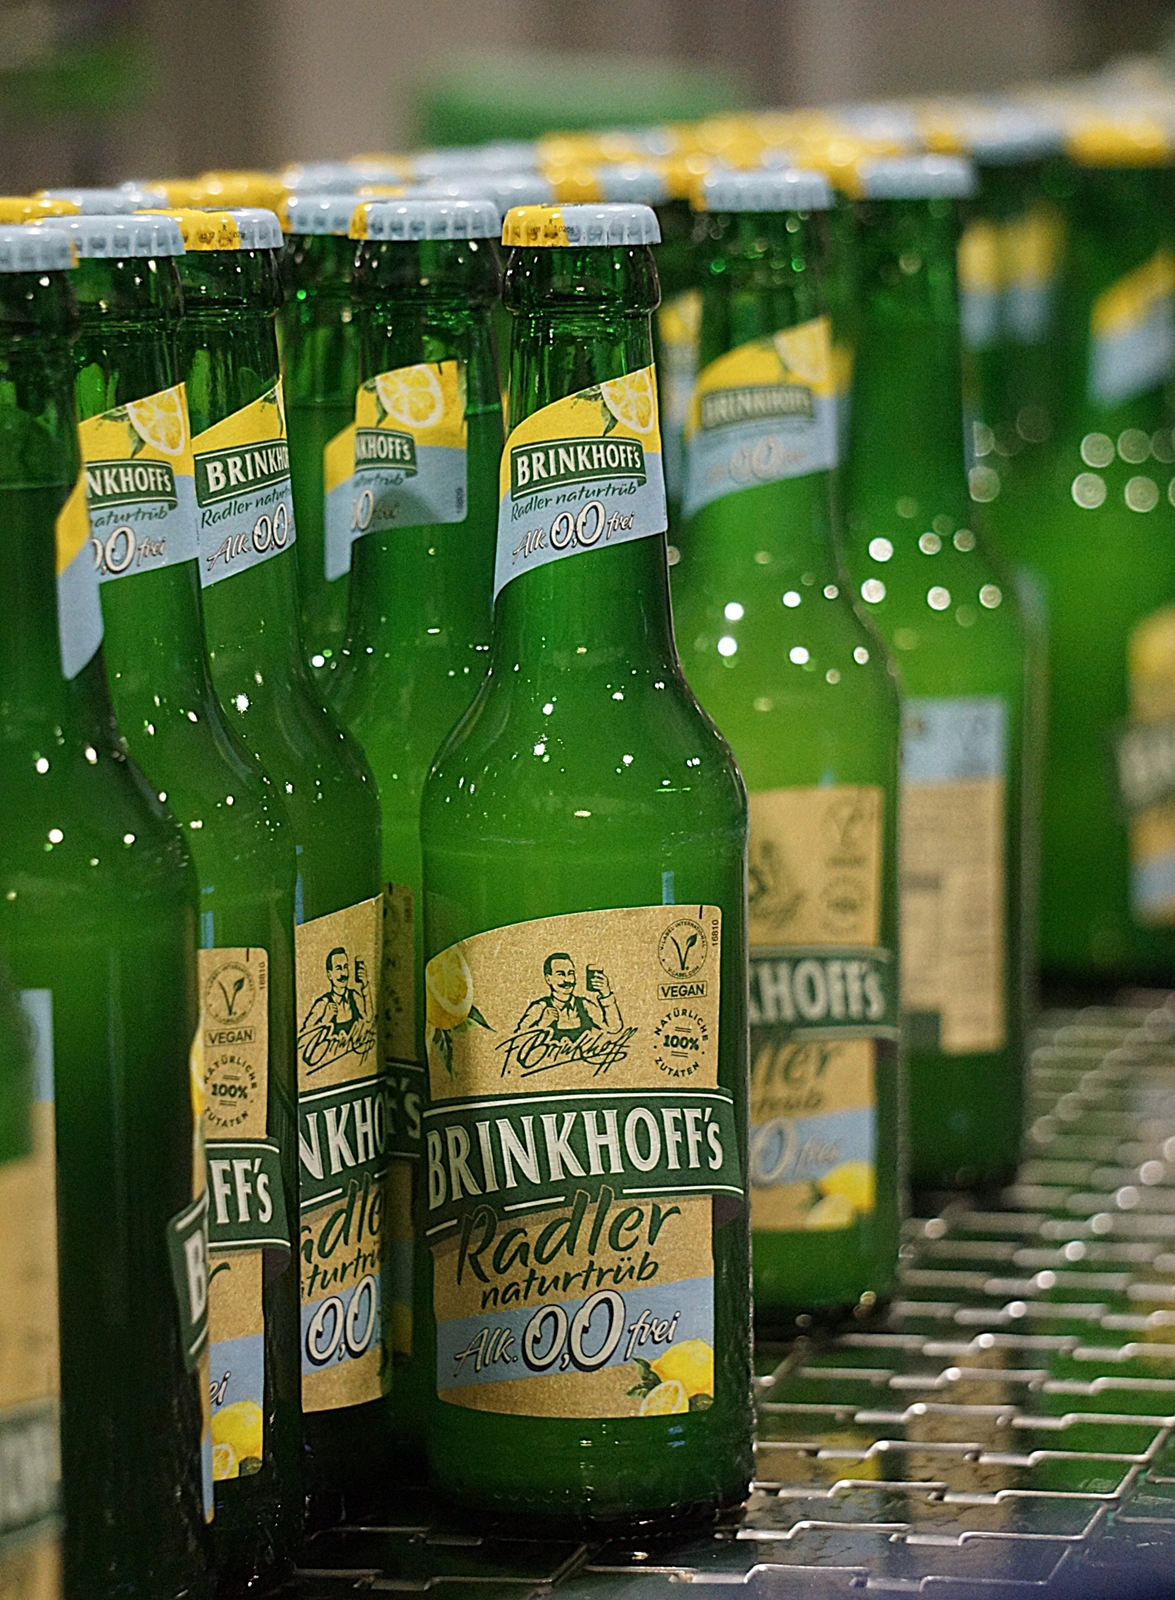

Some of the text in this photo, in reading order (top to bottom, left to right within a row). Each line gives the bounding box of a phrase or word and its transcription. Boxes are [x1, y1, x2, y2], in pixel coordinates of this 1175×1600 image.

[516, 443, 642, 488] BRINKHOFF's
[90, 506, 168, 528] aturtrüb
[201, 499, 254, 530] Radler
[511, 482, 638, 522] Radler naturtrüb
[511, 529, 549, 565] Alk.
[606, 511, 636, 540] frei
[711, 919, 719, 947] 16810
[660, 984, 706, 999] VEGAN
[207, 1029, 253, 1046] VEGAN
[654, 1007, 710, 1042] NATÜRLICHE
[662, 1034, 700, 1052] 100%
[654, 1056, 701, 1079] ZUTATEN
[211, 1083, 248, 1100] 100%
[425, 1106, 724, 1212] BRINKHOFF's
[208, 1157, 273, 1224] FF's
[455, 1184, 682, 1287] Radler
[480, 1251, 660, 1310] naturtrüb
[305, 1273, 377, 1367] 0,0
[453, 1289, 682, 1378] Alk. 0,0 frei
